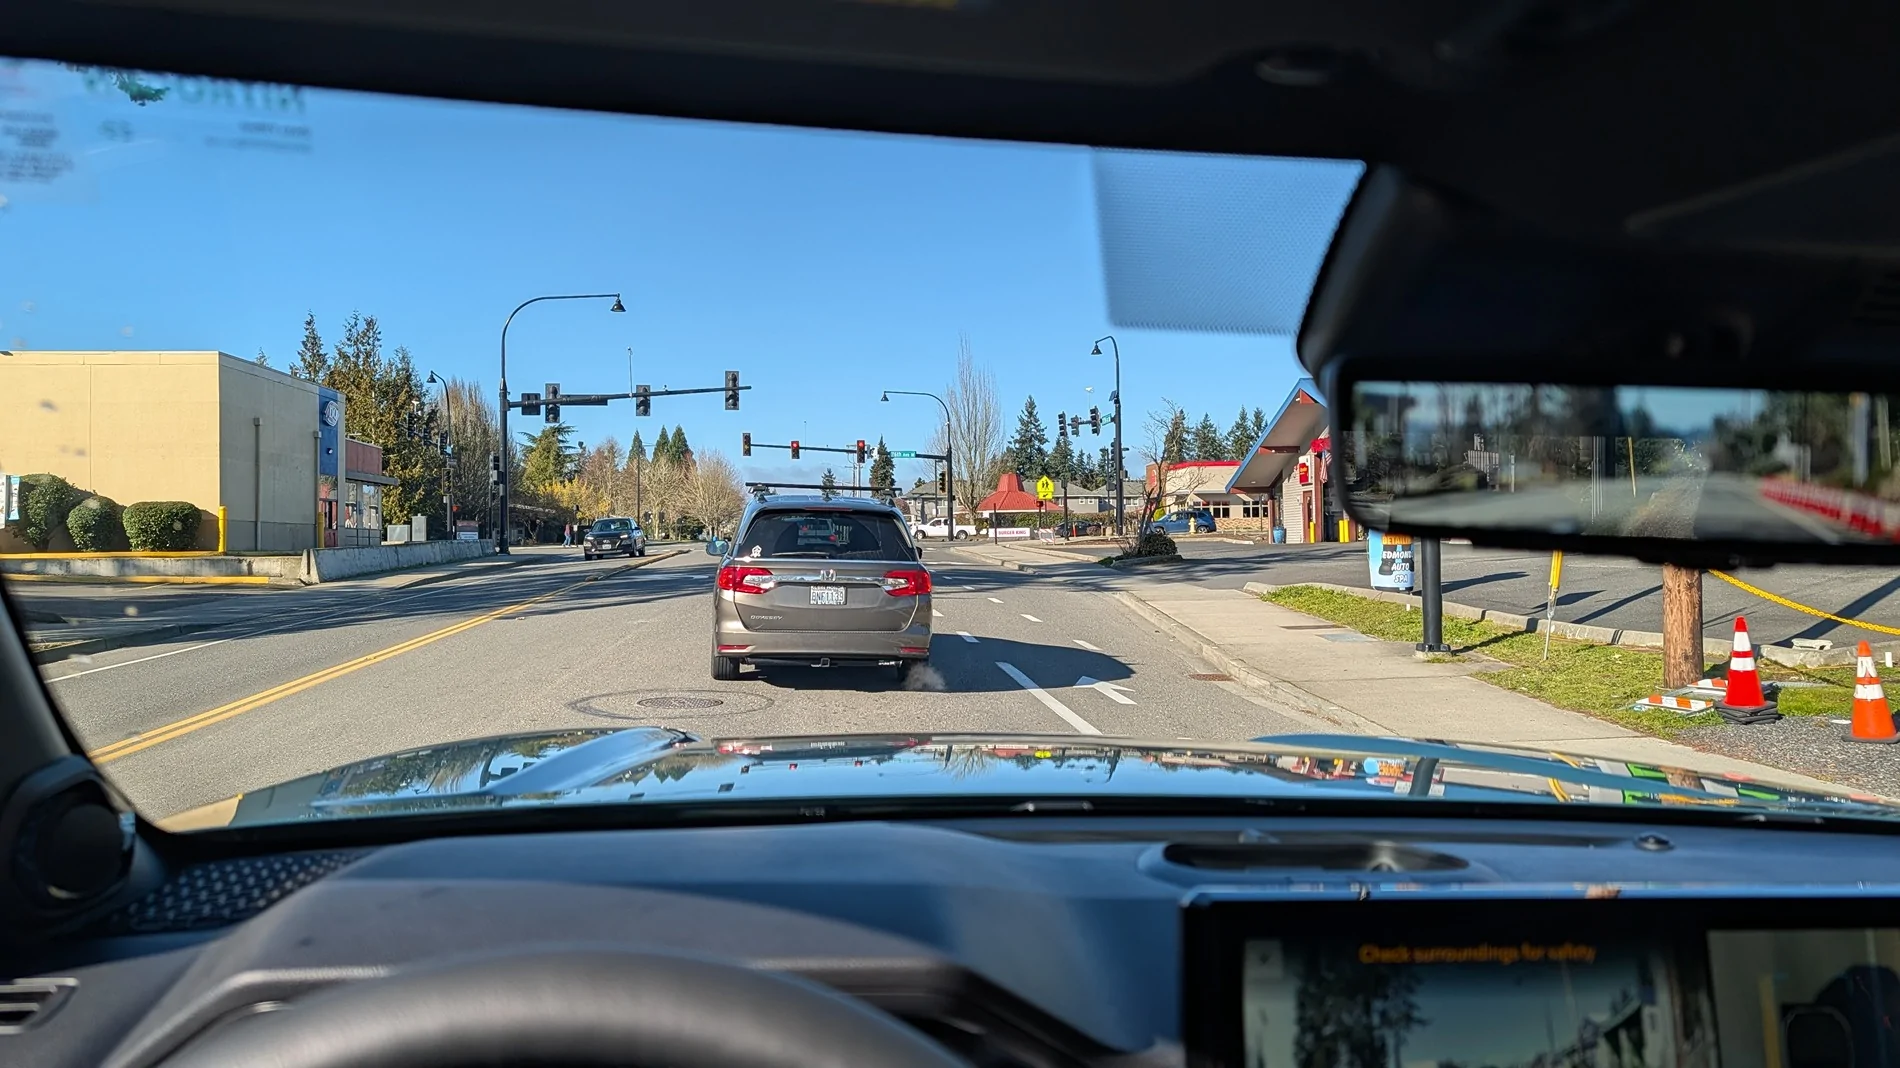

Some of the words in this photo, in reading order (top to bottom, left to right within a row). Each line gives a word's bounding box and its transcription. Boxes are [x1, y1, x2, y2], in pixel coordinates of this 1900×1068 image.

[1391, 562, 1410, 571] AUTO
[1394, 574, 1408, 583] SPA
[1358, 943, 1410, 964] Check
[1413, 942, 1520, 965] surroundings
[1521, 941, 1545, 961] for
[1546, 941, 1596, 965] safety
